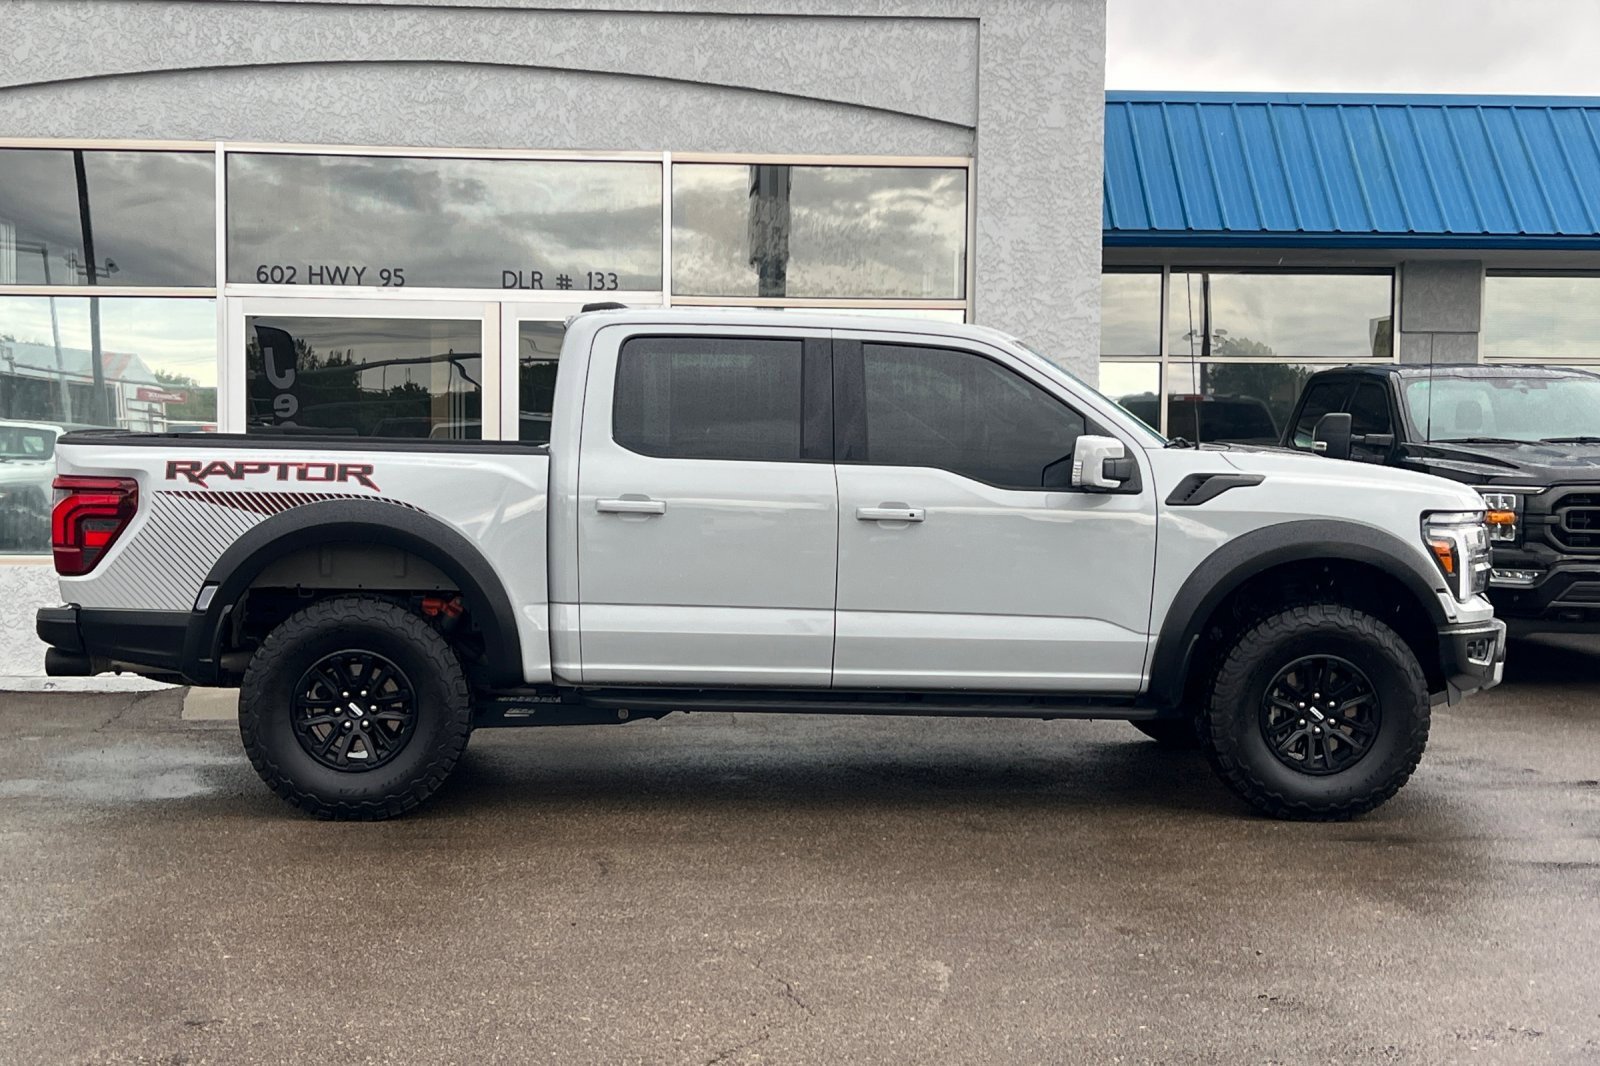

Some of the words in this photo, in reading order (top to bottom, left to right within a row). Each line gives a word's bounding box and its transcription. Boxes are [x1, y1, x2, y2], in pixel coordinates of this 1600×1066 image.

[256, 264, 297, 284] 602
[308, 265, 367, 285] HWY
[379, 268, 405, 287] 95
[502, 270, 543, 290] DLR
[556, 273, 573, 290] #
[587, 271, 619, 291] 133
[165, 460, 381, 492] RAPTOR
